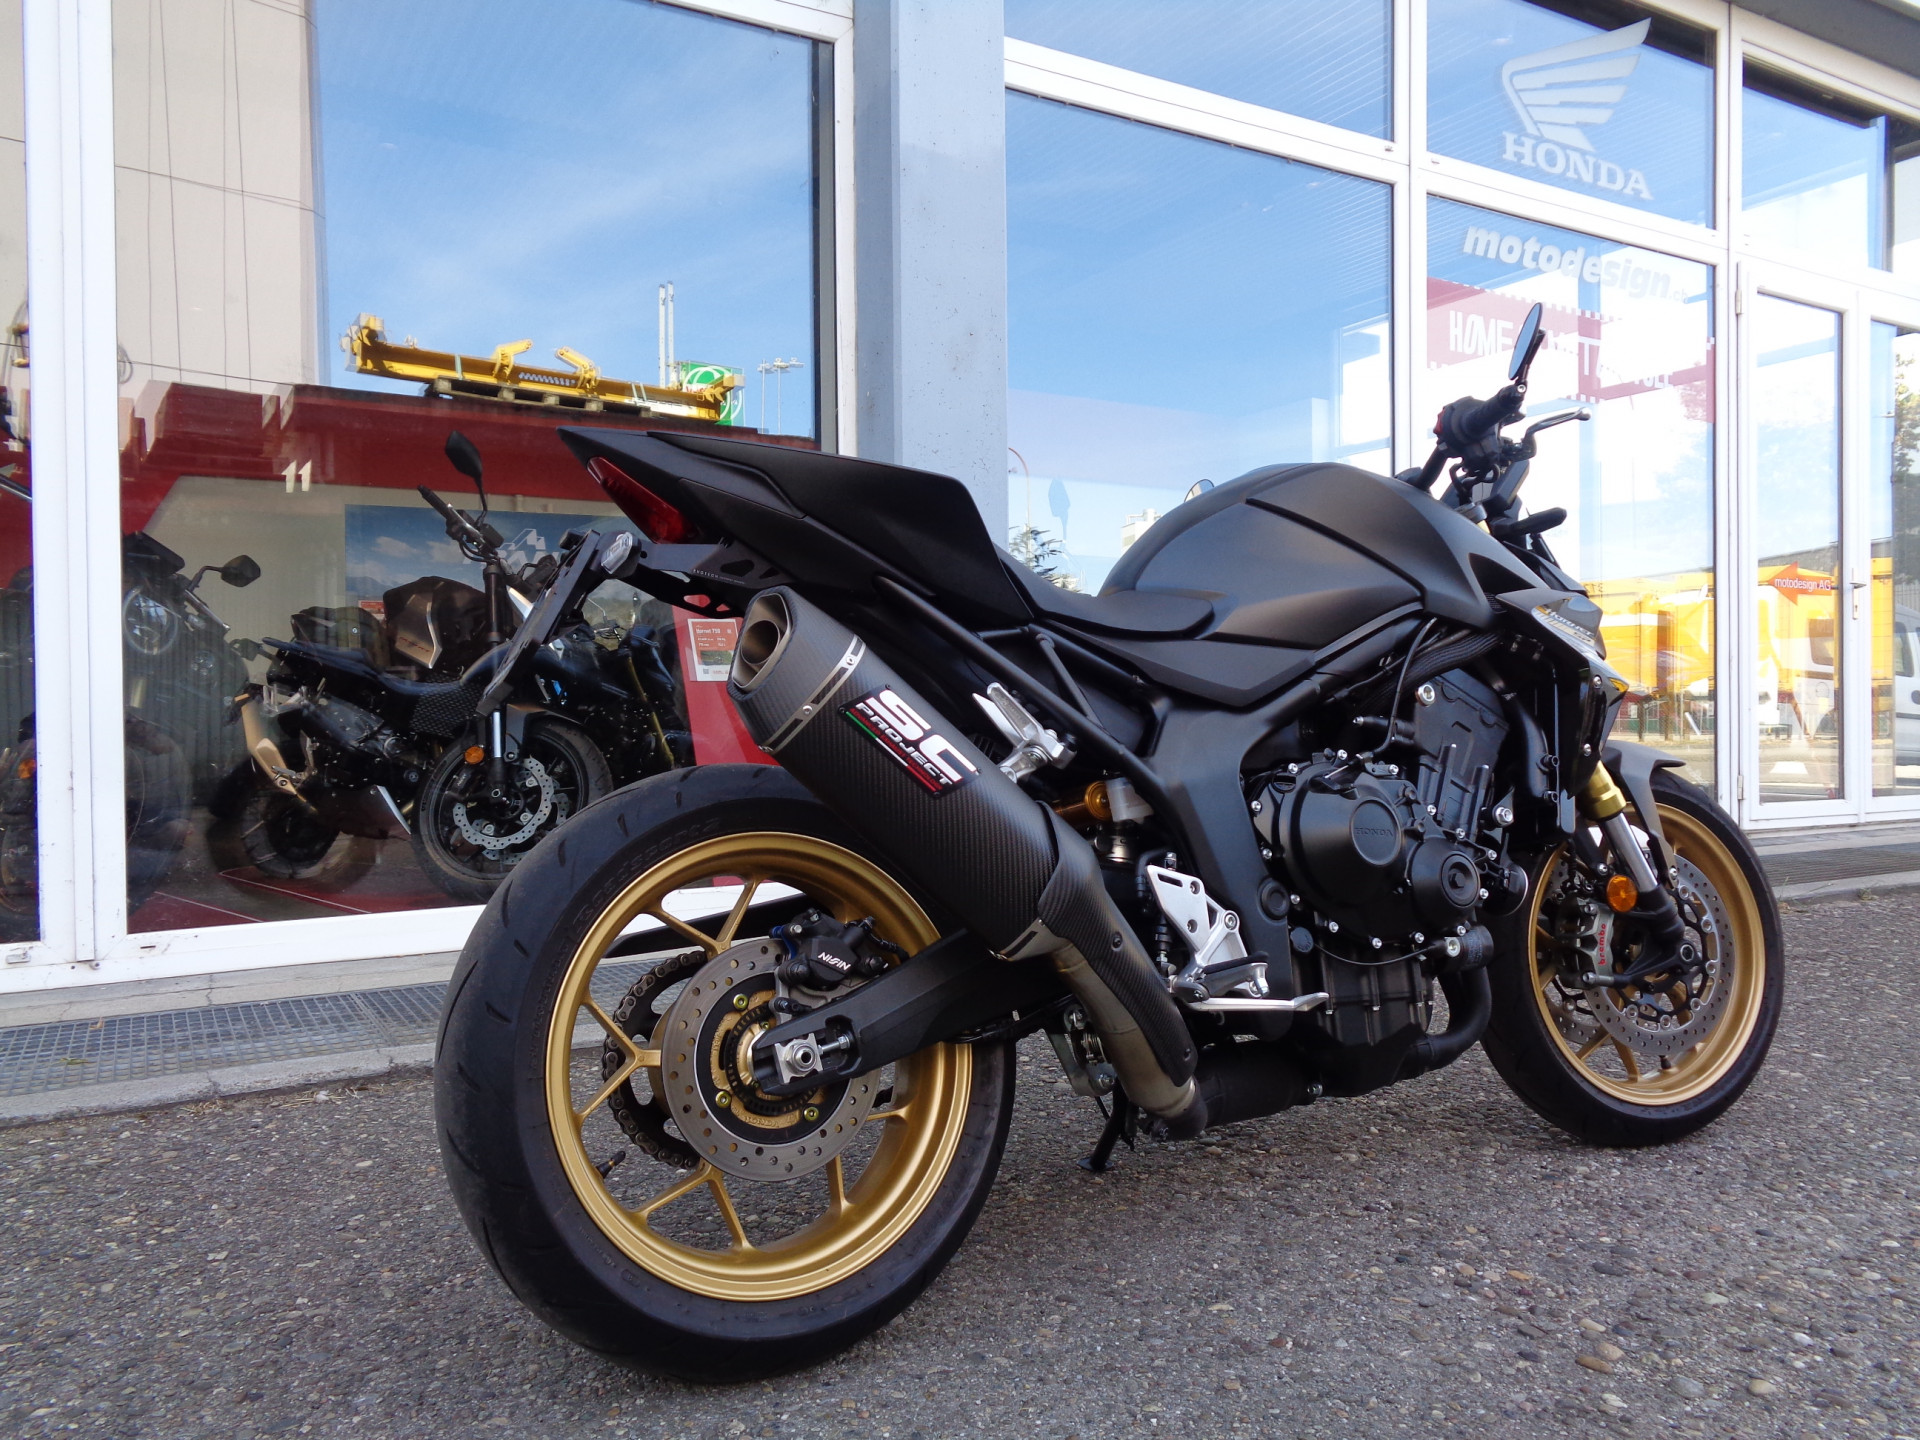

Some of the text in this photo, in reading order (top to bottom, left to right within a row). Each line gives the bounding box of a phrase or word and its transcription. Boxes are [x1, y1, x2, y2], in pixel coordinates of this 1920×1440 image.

[1502, 131, 1655, 200] HONDA
[1775, 577, 1831, 592] motodesign AG
[856, 703, 953, 785] PROJECT
[1354, 827, 1394, 837] HONDA
[1598, 923, 1607, 966] brembo
